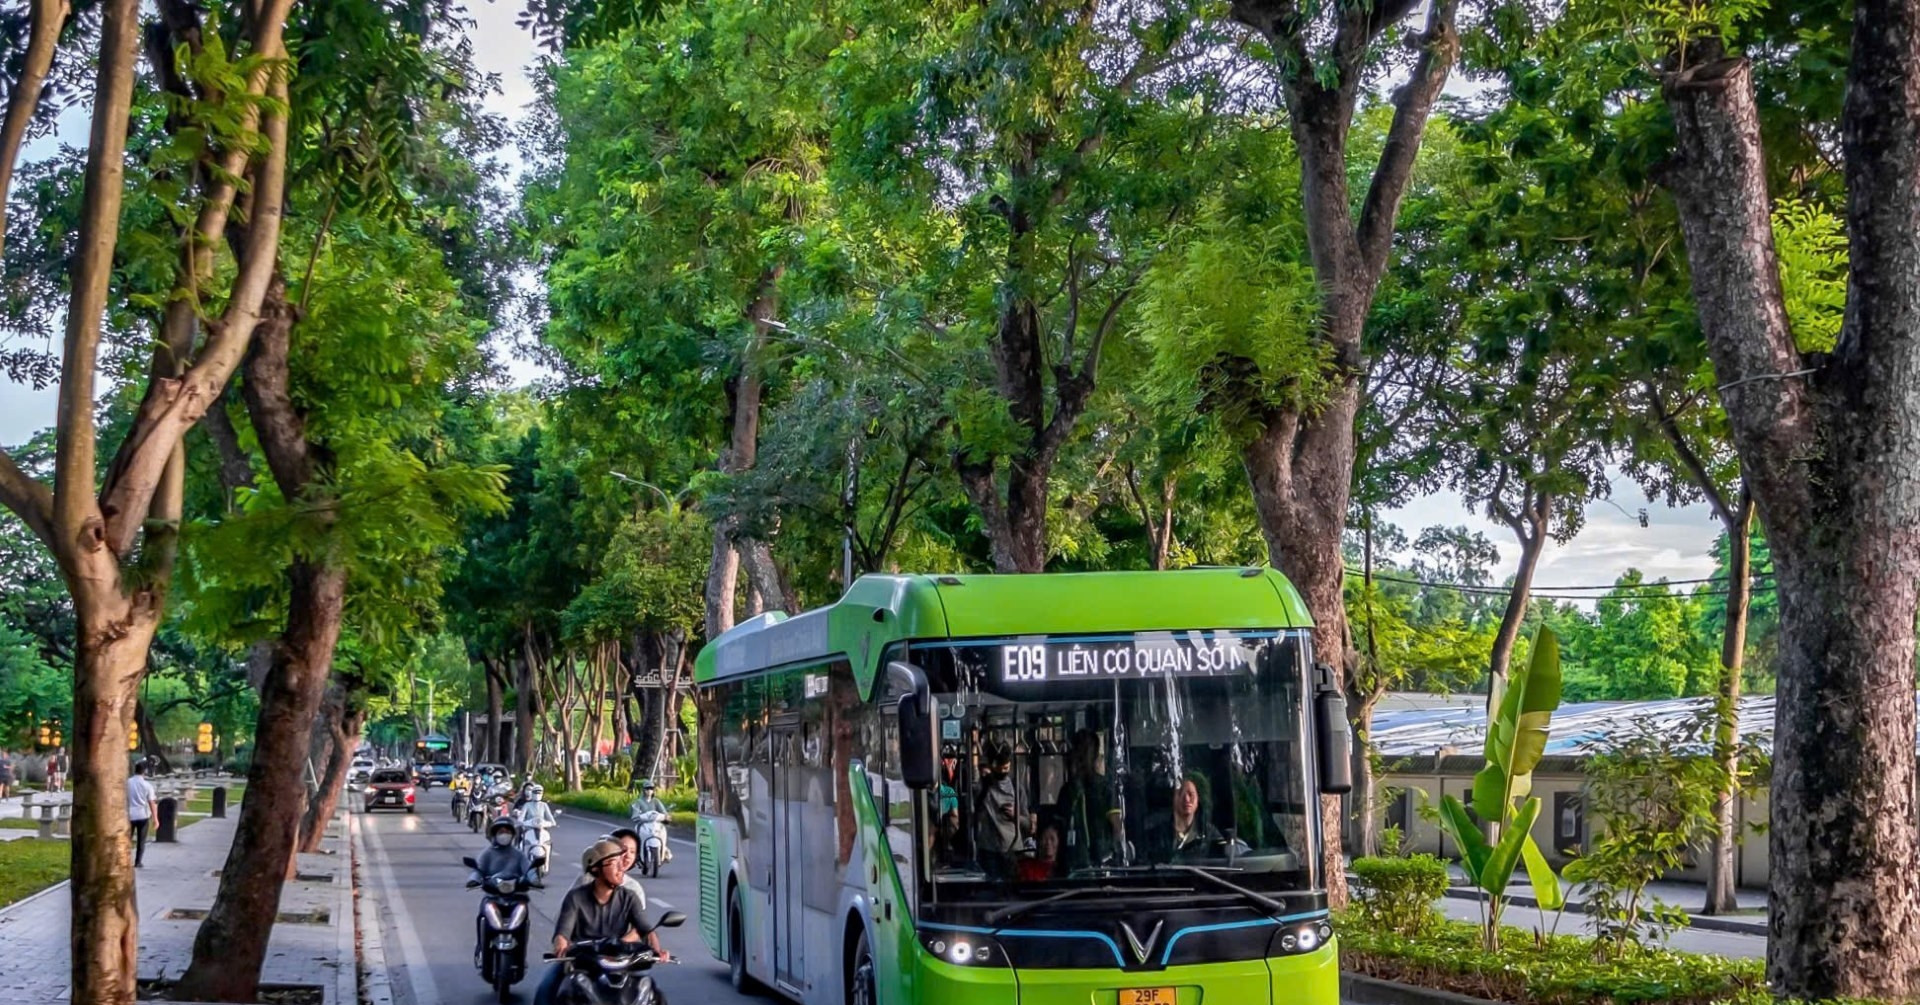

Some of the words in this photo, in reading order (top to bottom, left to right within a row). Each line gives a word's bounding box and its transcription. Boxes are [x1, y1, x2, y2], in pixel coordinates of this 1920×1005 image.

[1004, 645, 1046, 680] E09
[1058, 645, 1098, 675] LIÊN
[1103, 647, 1131, 674] CƠ
[1135, 649, 1192, 675] QUAN
[1197, 638, 1225, 670] SỞ
[1135, 989, 1159, 1002] 29F
